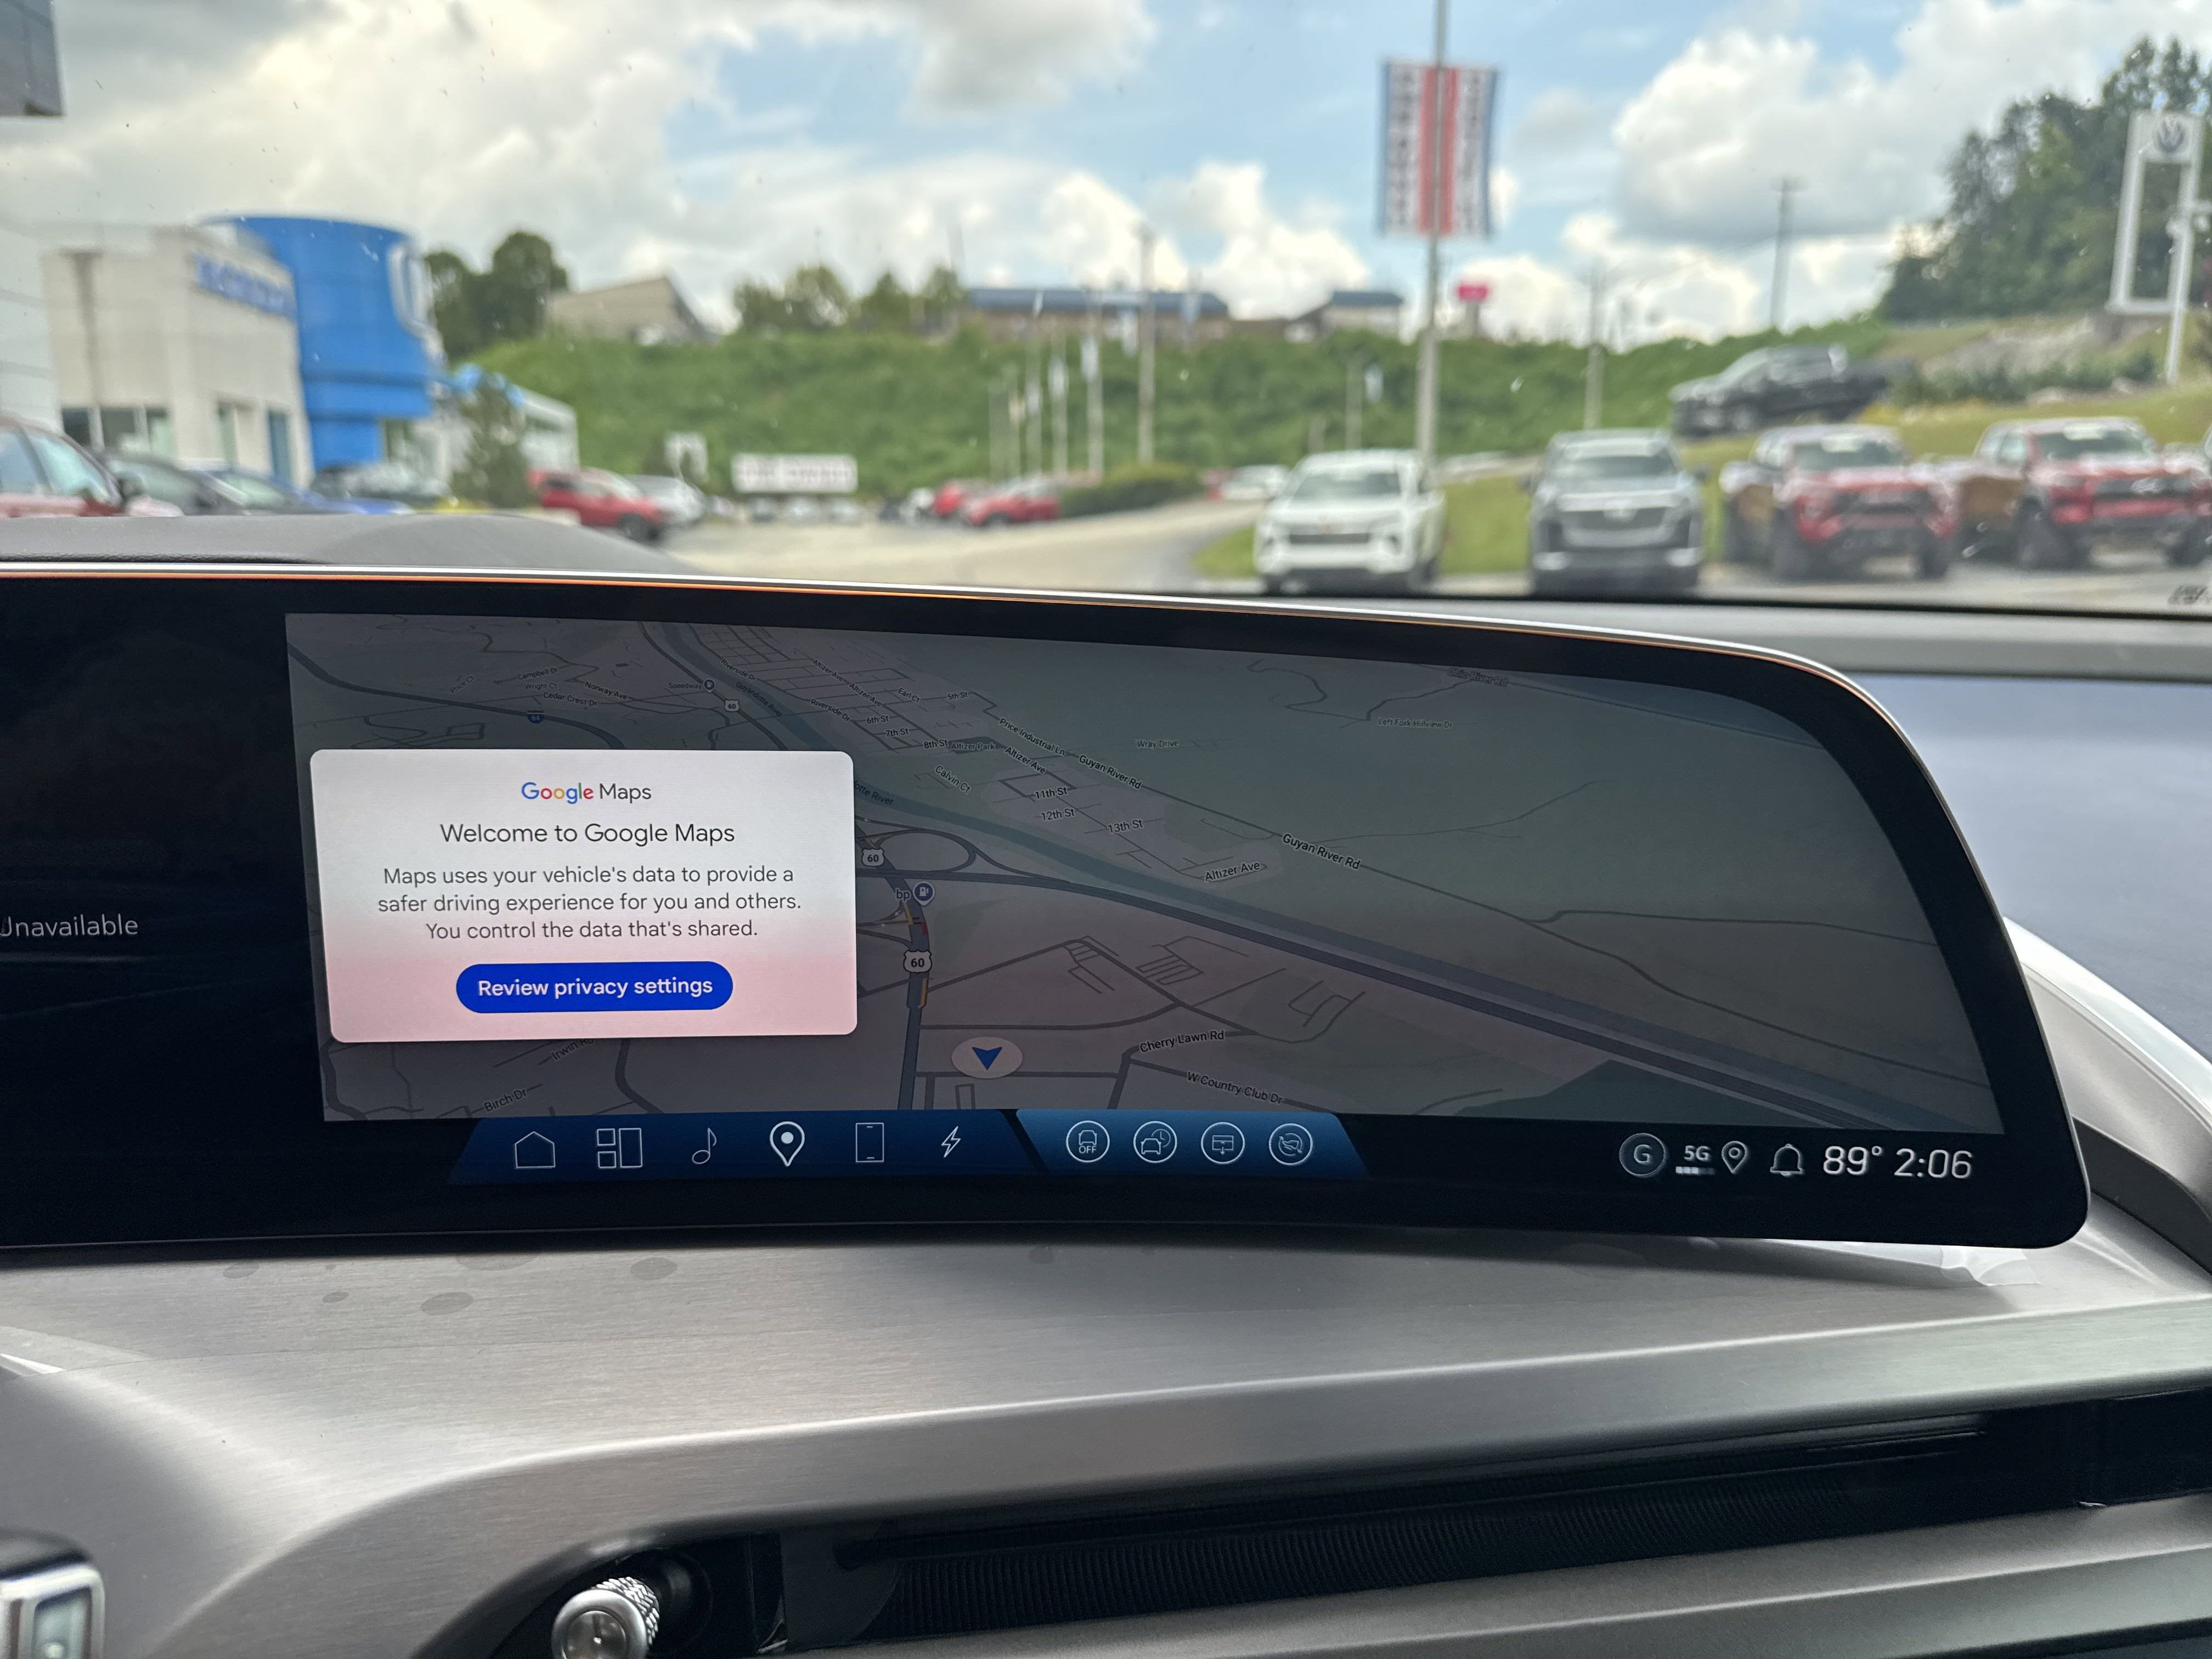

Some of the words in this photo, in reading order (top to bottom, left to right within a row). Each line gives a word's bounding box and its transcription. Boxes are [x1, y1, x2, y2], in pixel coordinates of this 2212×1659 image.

[518, 669, 549, 680] Campbell
[721, 659, 748, 678] Riverside
[812, 659, 833, 674] Altizer
[832, 672, 843, 681] Ave
[544, 692, 566, 700] Cedar
[567, 695, 587, 705] Crest
[585, 681, 613, 696] Norway
[613, 691, 628, 700] Ave
[850, 684, 870, 699] Altizer
[870, 696, 882, 707] Ave
[898, 688, 911, 698] Earl
[912, 695, 919, 703] Ct
[811, 699, 842, 716] Riverside
[842, 713, 850, 722] Dr
[924, 741, 937, 749] 8th
[1000, 718, 1018, 733] Price
[1019, 729, 1054, 752] Industrial
[1055, 746, 1065, 756] Ln
[1137, 741, 1156, 749] Wray
[1005, 747, 1031, 765] Altizer
[1031, 761, 1046, 774] Ave
[935, 765, 961, 787] Calvin
[960, 782, 970, 793] Ct
[1079, 755, 1106, 774] Guyan
[1107, 766, 1128, 782] River
[1130, 777, 1142, 789] Rd
[521, 782, 594, 805] Google
[599, 783, 652, 804] Maps
[871, 791, 894, 805] River
[1035, 788, 1056, 799] 11th
[1057, 786, 1068, 795] St
[1041, 810, 1063, 821] 12th
[1064, 808, 1075, 817] St
[440, 823, 548, 843] Welcome
[554, 825, 578, 842] to
[584, 823, 668, 847] Google
[675, 823, 735, 847] Maps
[1108, 822, 1130, 833] 13th
[1132, 819, 1143, 829] St
[867, 854, 879, 862] 60
[1283, 833, 1316, 853] Guyan
[1317, 846, 1344, 864] River
[1345, 857, 1361, 870] Rd
[384, 868, 437, 888] Maps
[443, 871, 488, 884] uses
[493, 871, 537, 887] your
[543, 865, 627, 883] vehicle's
[633, 865, 675, 882] data
[681, 867, 701, 882] to
[707, 865, 777, 886] provide
[783, 870, 793, 882] a
[1205, 866, 1238, 881] Altizer
[1241, 862, 1261, 873] Ave
[378, 894, 427, 912] safer
[434, 894, 500, 916] driving
[506, 893, 614, 915] experience
[619, 893, 647, 910] for
[653, 897, 687, 913] you
[694, 892, 729, 909] and
[736, 892, 801, 909] others.
[896, 889, 910, 900] bp
[426, 923, 460, 939] You
[467, 921, 535, 939] control
[541, 921, 573, 938] the
[579, 921, 622, 938] data
[628, 920, 682, 937] that's
[688, 919, 758, 936] shared.
[911, 958, 925, 967] 60
[477, 978, 549, 996] Review
[554, 978, 629, 1000] privacy
[634, 976, 713, 998] settings
[1140, 1037, 1175, 1052] Cherry
[1178, 1032, 1207, 1044] Lawn
[1210, 1030, 1224, 1040] Rd
[551, 1042, 579, 1060] Irwin
[1187, 1071, 1198, 1082] W
[1200, 1075, 1242, 1095] Country
[1244, 1086, 1268, 1100] Club
[1270, 1093, 1283, 1104] Dr
[484, 1094, 513, 1111] Birch
[514, 1089, 526, 1099] Dr
[1079, 1146, 1097, 1154] OFF
[1683, 1145, 1711, 1161] 5G
[1822, 1145, 1882, 1175] 89°
[1894, 1147, 1973, 1179] 2:06
